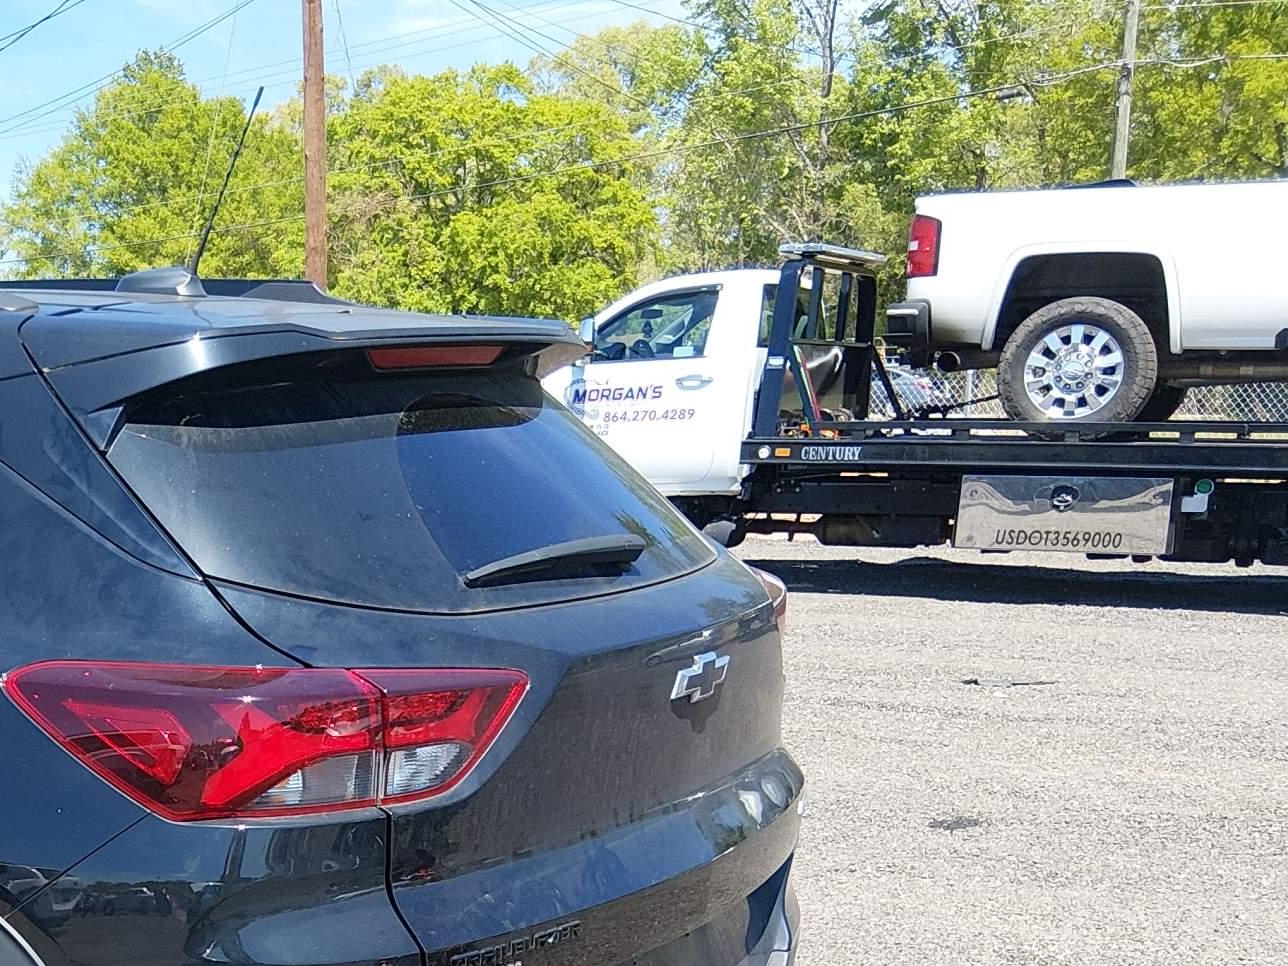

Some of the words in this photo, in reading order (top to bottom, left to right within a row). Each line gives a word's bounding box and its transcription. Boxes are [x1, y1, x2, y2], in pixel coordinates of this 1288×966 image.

[573, 384, 663, 404] MORGAN'S
[603, 408, 695, 422] 864.270.4289
[801, 446, 862, 460] CENTURY
[995, 529, 1123, 549] USDOT3569000
